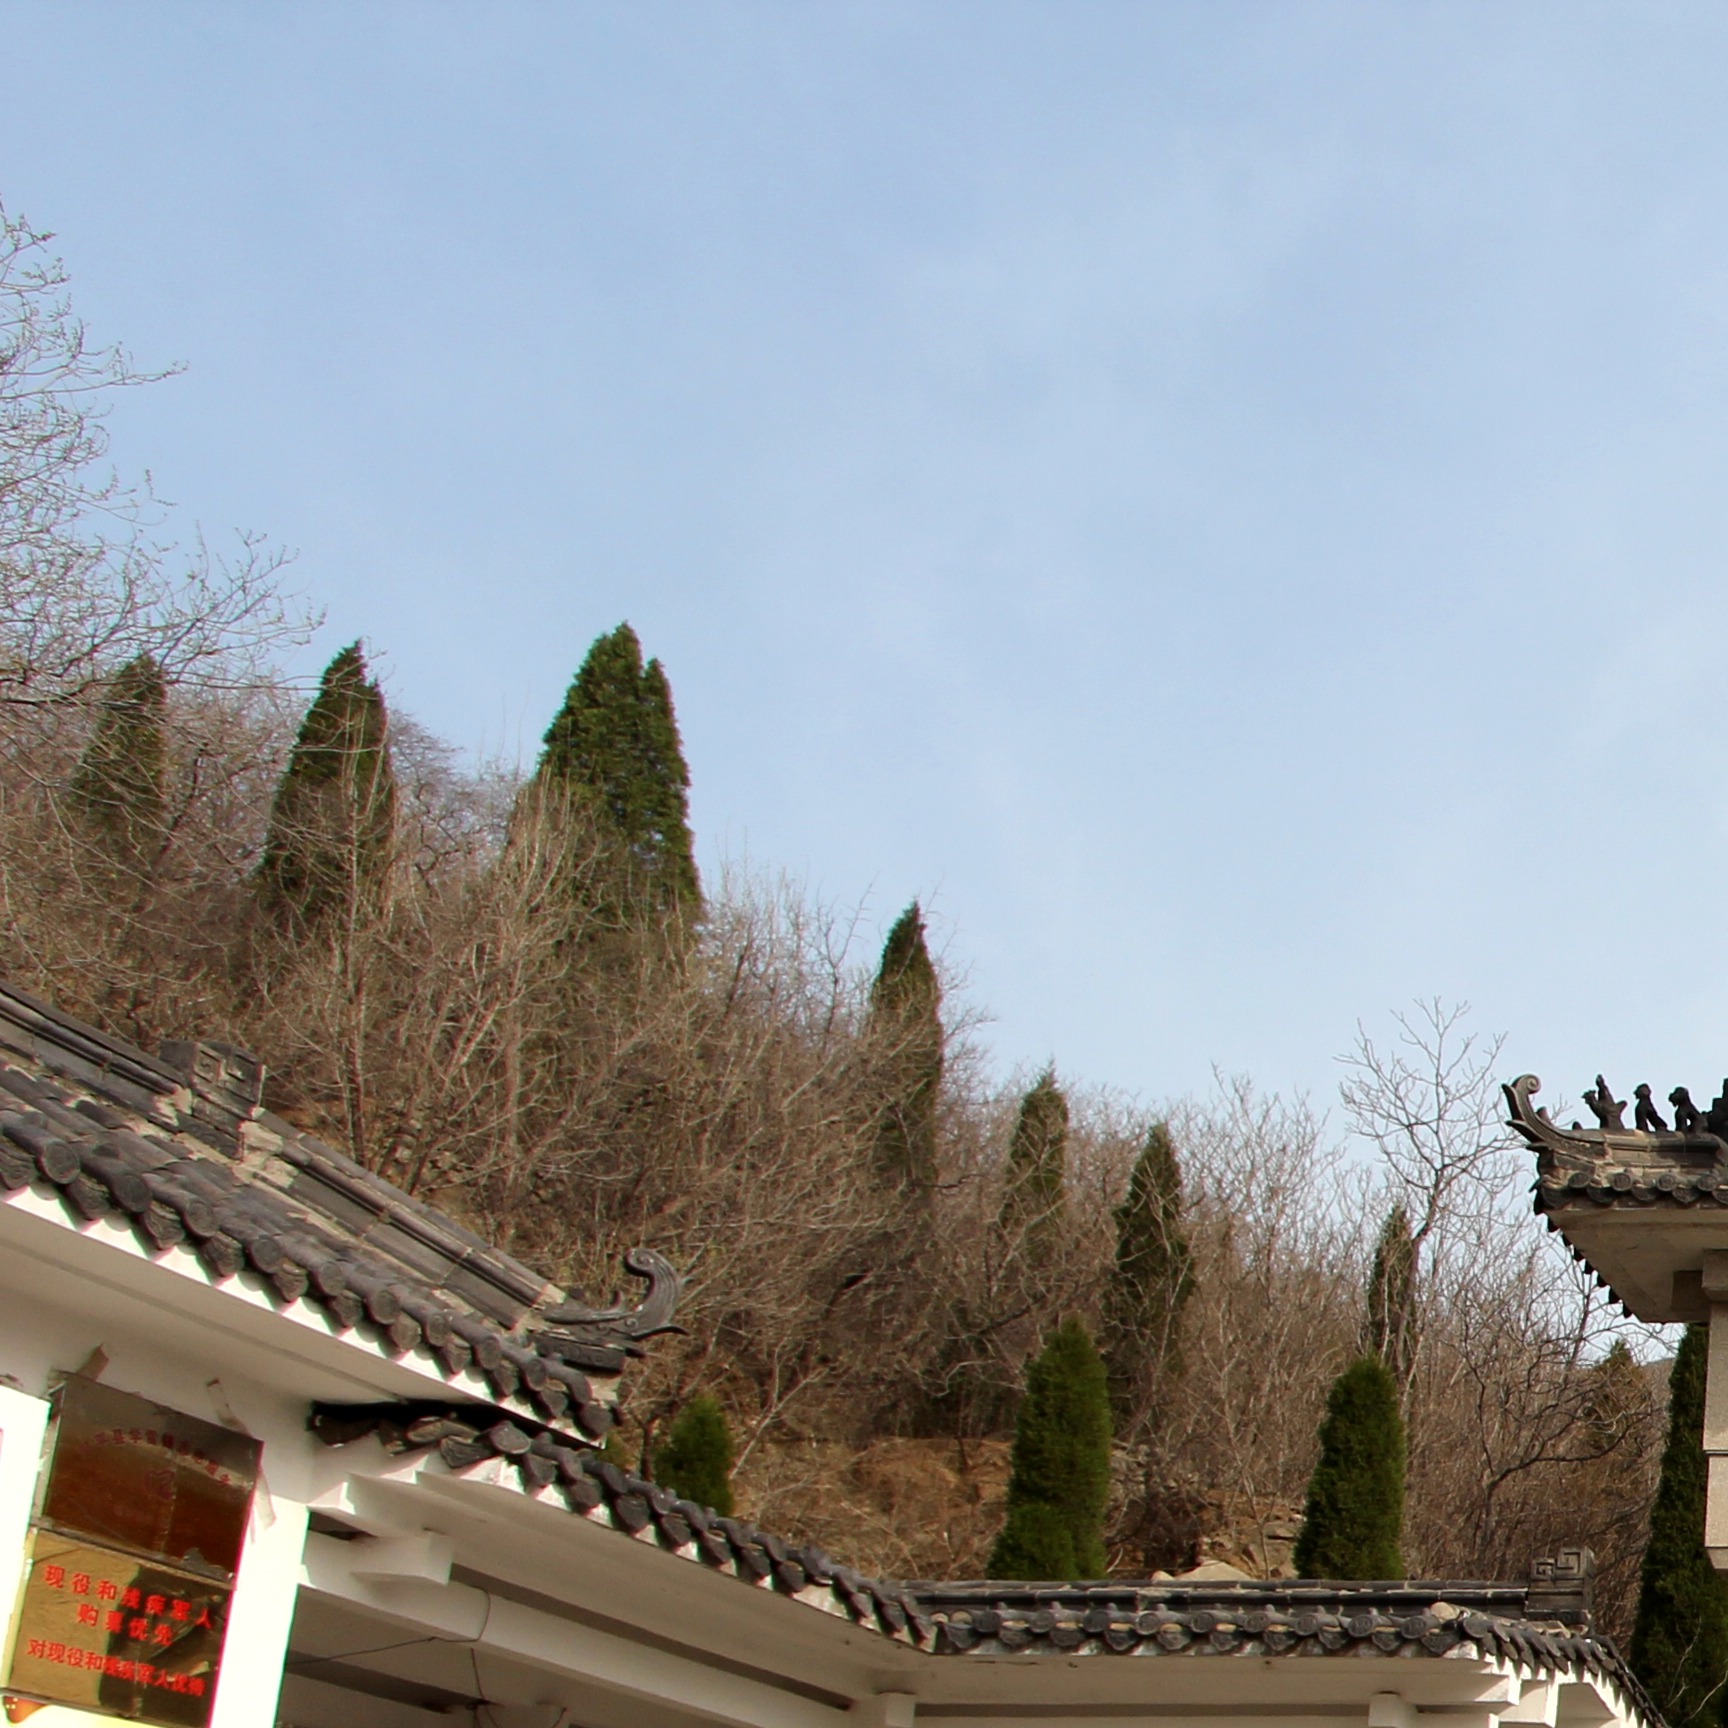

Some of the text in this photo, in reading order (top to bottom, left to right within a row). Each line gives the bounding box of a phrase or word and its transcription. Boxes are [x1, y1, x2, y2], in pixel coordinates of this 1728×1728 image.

[44, 1564, 213, 1631] 现役和残疾军人
[77, 1603, 174, 1647] 购票优先
